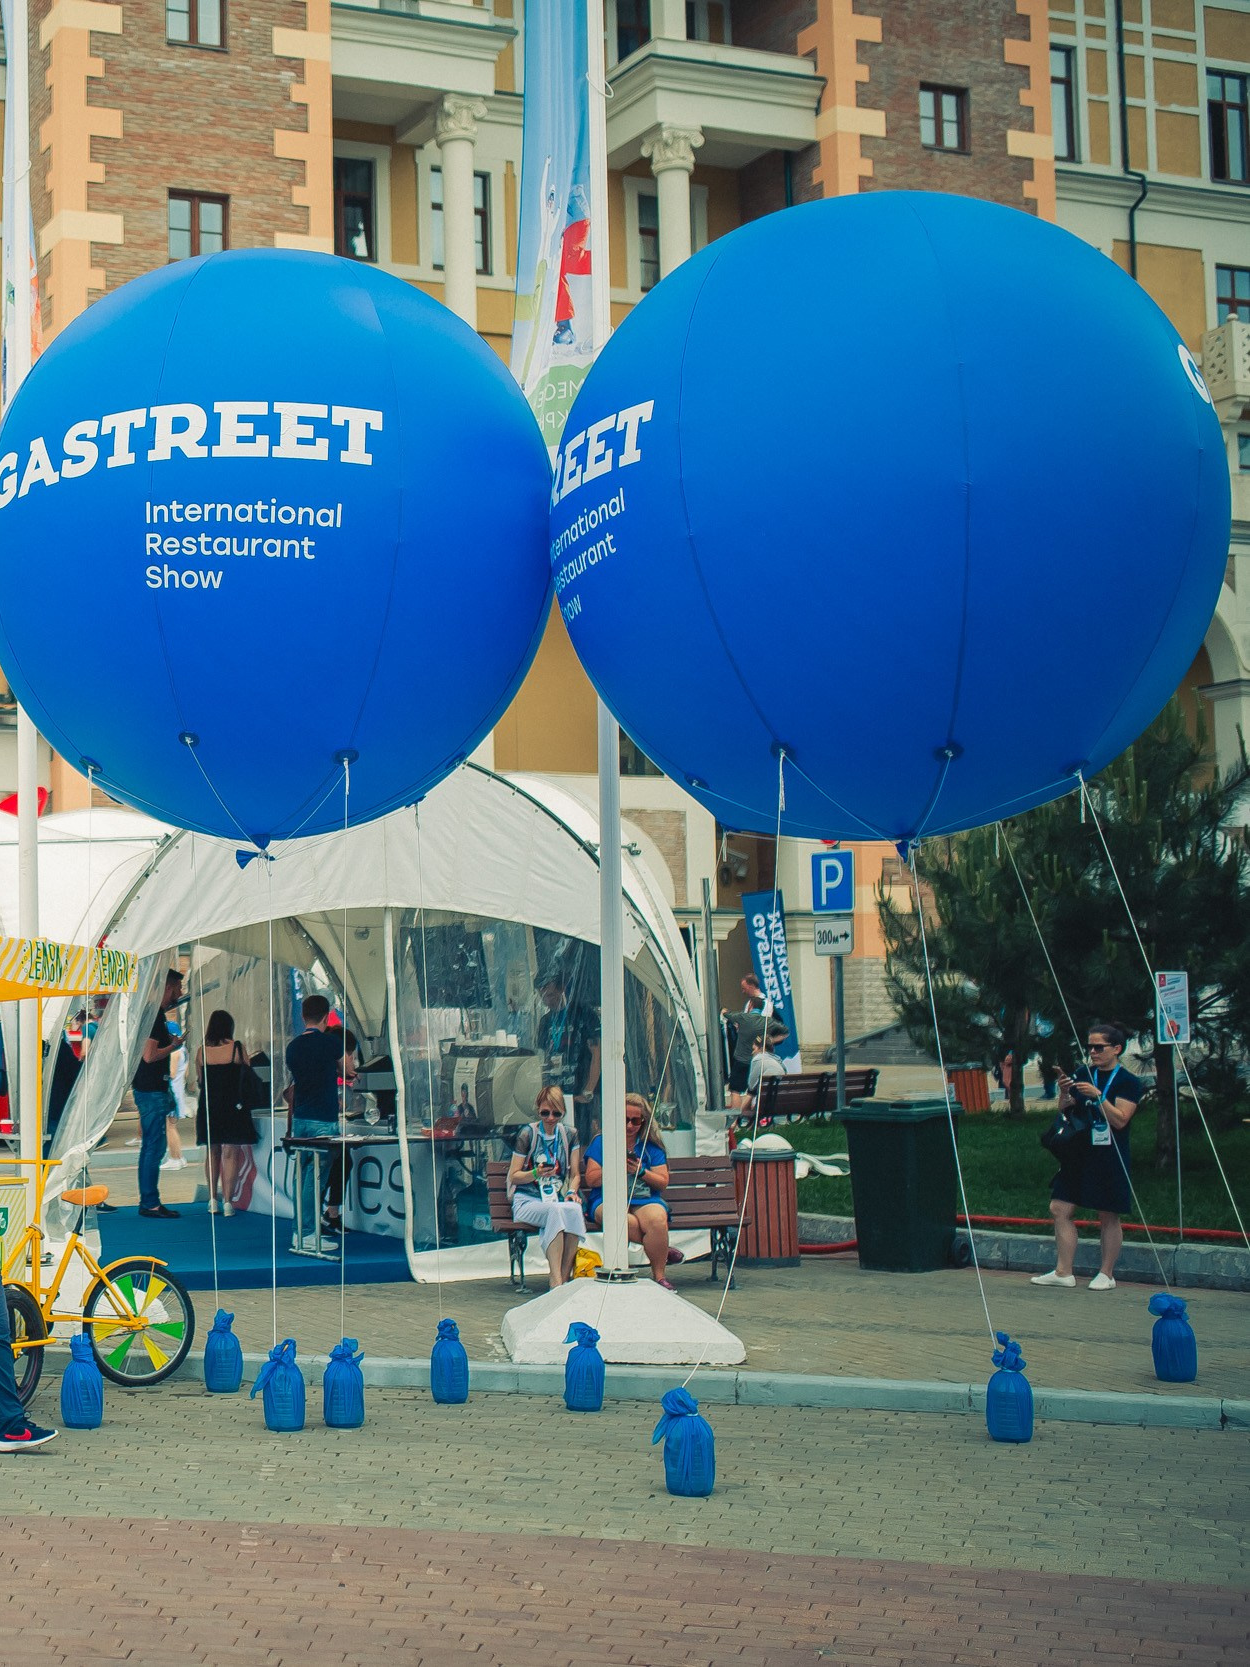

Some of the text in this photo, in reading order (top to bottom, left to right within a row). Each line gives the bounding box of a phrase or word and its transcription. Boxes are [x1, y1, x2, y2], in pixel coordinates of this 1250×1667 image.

[553, 400, 655, 508] REET
[145, 498, 343, 528] International
[551, 487, 626, 565] ternational
[145, 532, 316, 560] Restaurant
[145, 564, 223, 589] Show
[821, 858, 844, 906] P
[817, 929, 839, 946] 300м
